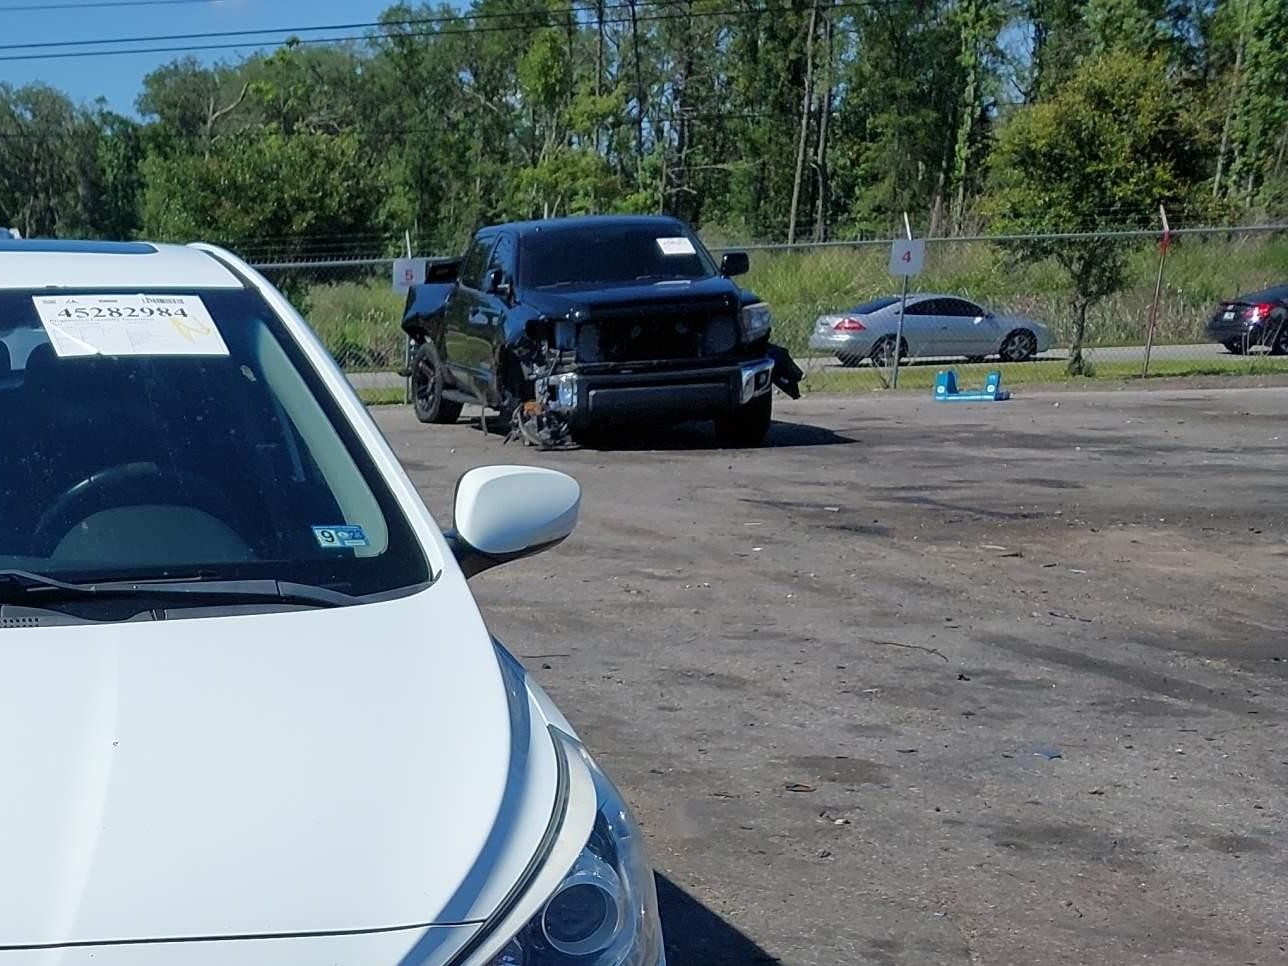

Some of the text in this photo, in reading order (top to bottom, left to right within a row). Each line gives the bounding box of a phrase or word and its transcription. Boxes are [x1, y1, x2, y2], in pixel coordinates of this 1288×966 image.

[902, 251, 911, 263] 4
[405, 269, 414, 281] 5
[57, 307, 188, 318] 45282984
[320, 530, 335, 543] 9
